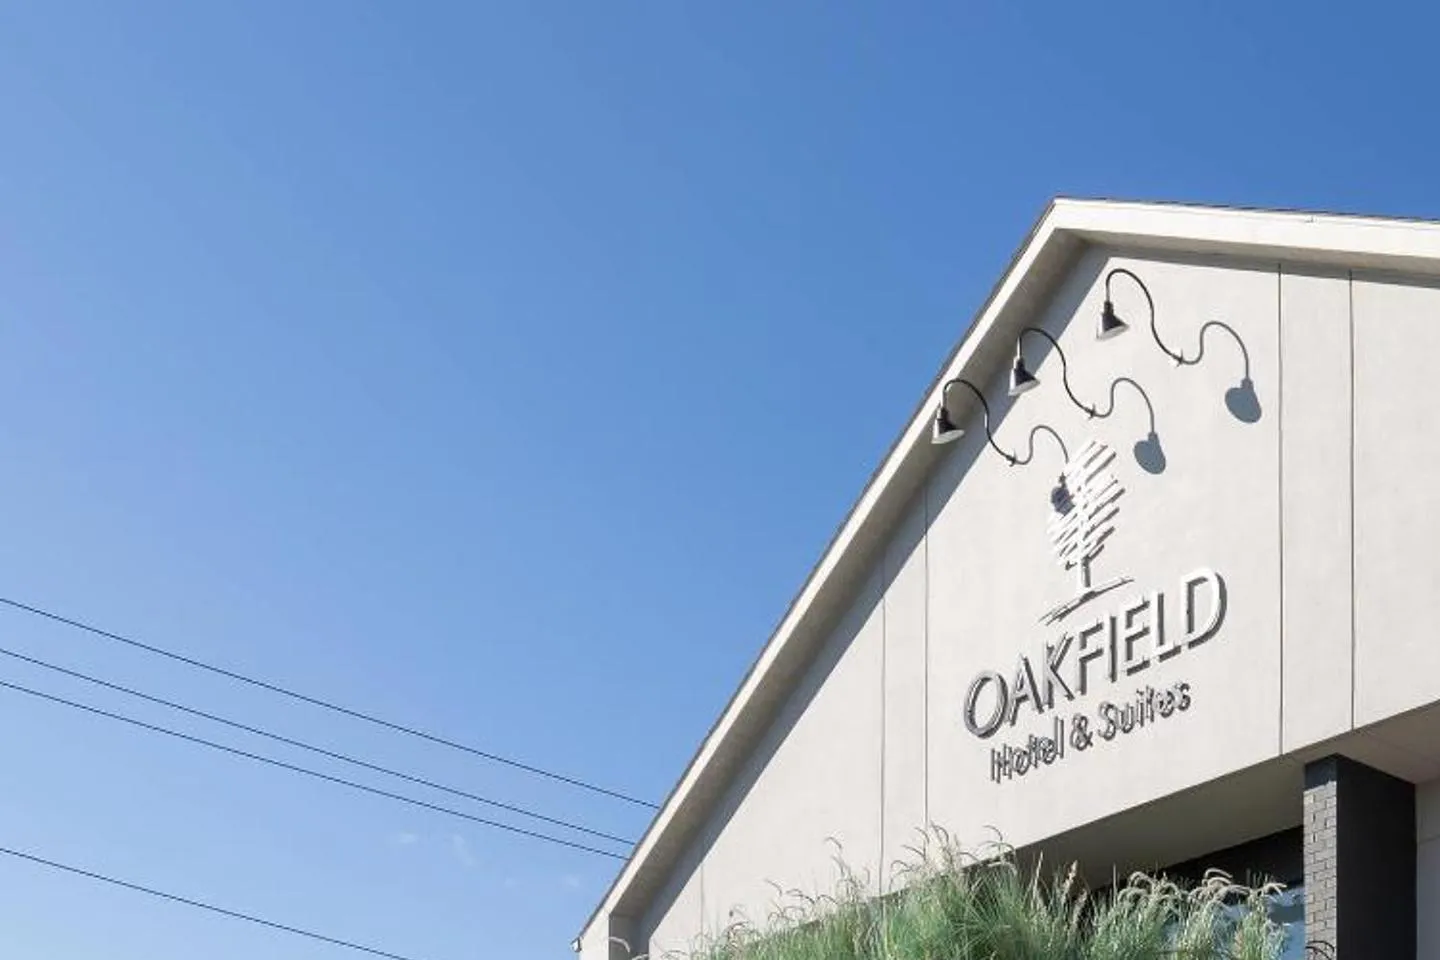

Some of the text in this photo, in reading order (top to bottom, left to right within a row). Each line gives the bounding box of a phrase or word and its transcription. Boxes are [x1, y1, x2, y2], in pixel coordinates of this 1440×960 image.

[963, 569, 1228, 740] OAKFIELD
[990, 683, 1191, 784] Hotel & Suites
